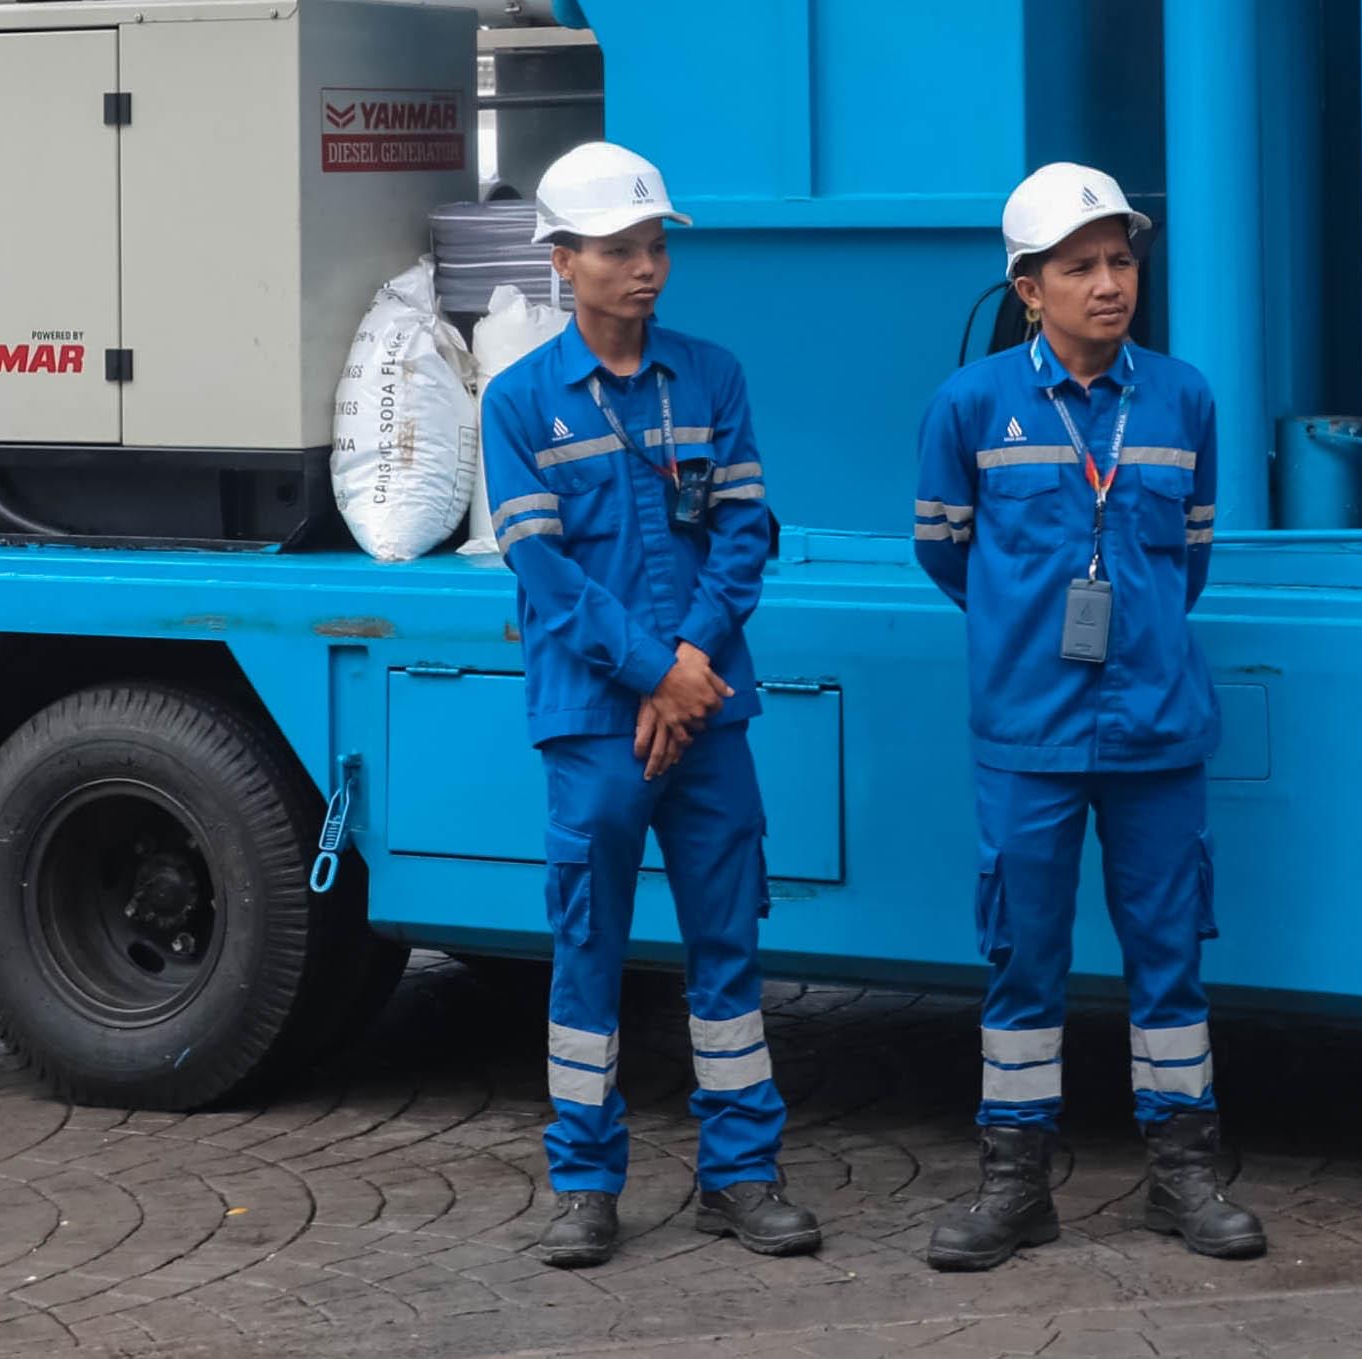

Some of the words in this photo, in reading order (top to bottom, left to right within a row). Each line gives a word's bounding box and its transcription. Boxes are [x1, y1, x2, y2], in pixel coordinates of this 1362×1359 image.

[361, 102, 457, 130] YANMAR
[328, 142, 378, 163] DIESEL
[381, 142, 461, 163] GENERATOR
[32, 331, 71, 340] POWERED
[73, 331, 84, 340] BY
[380, 384, 396, 433] SODA
[373, 441, 393, 504] CAUSIC
